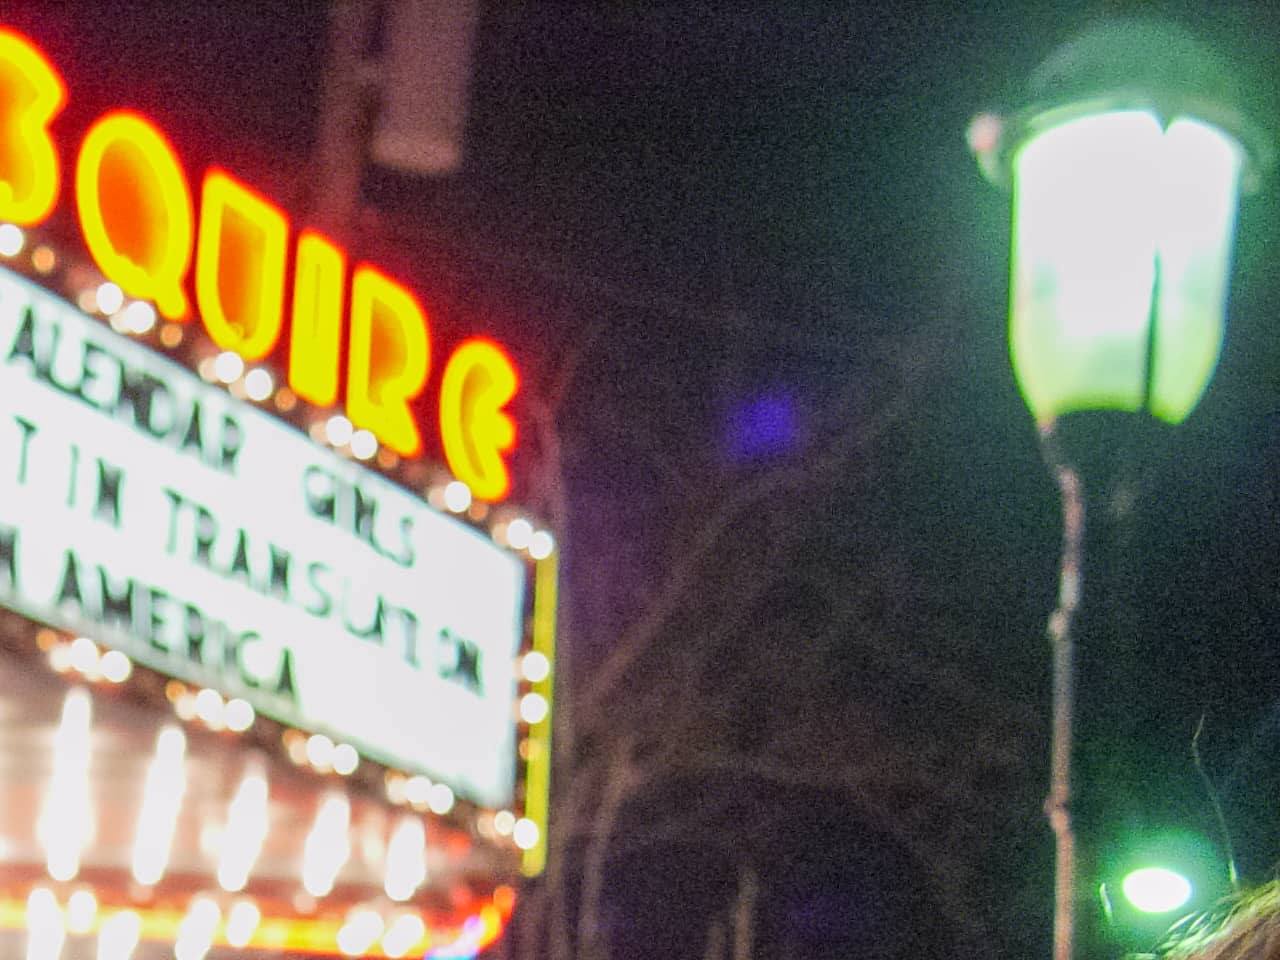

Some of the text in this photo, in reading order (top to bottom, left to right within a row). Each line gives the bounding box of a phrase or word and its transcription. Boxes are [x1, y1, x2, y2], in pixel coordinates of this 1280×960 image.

[66, 443, 125, 530] IN
[303, 464, 416, 570] GIRLS
[55, 546, 303, 706] AMERICA
